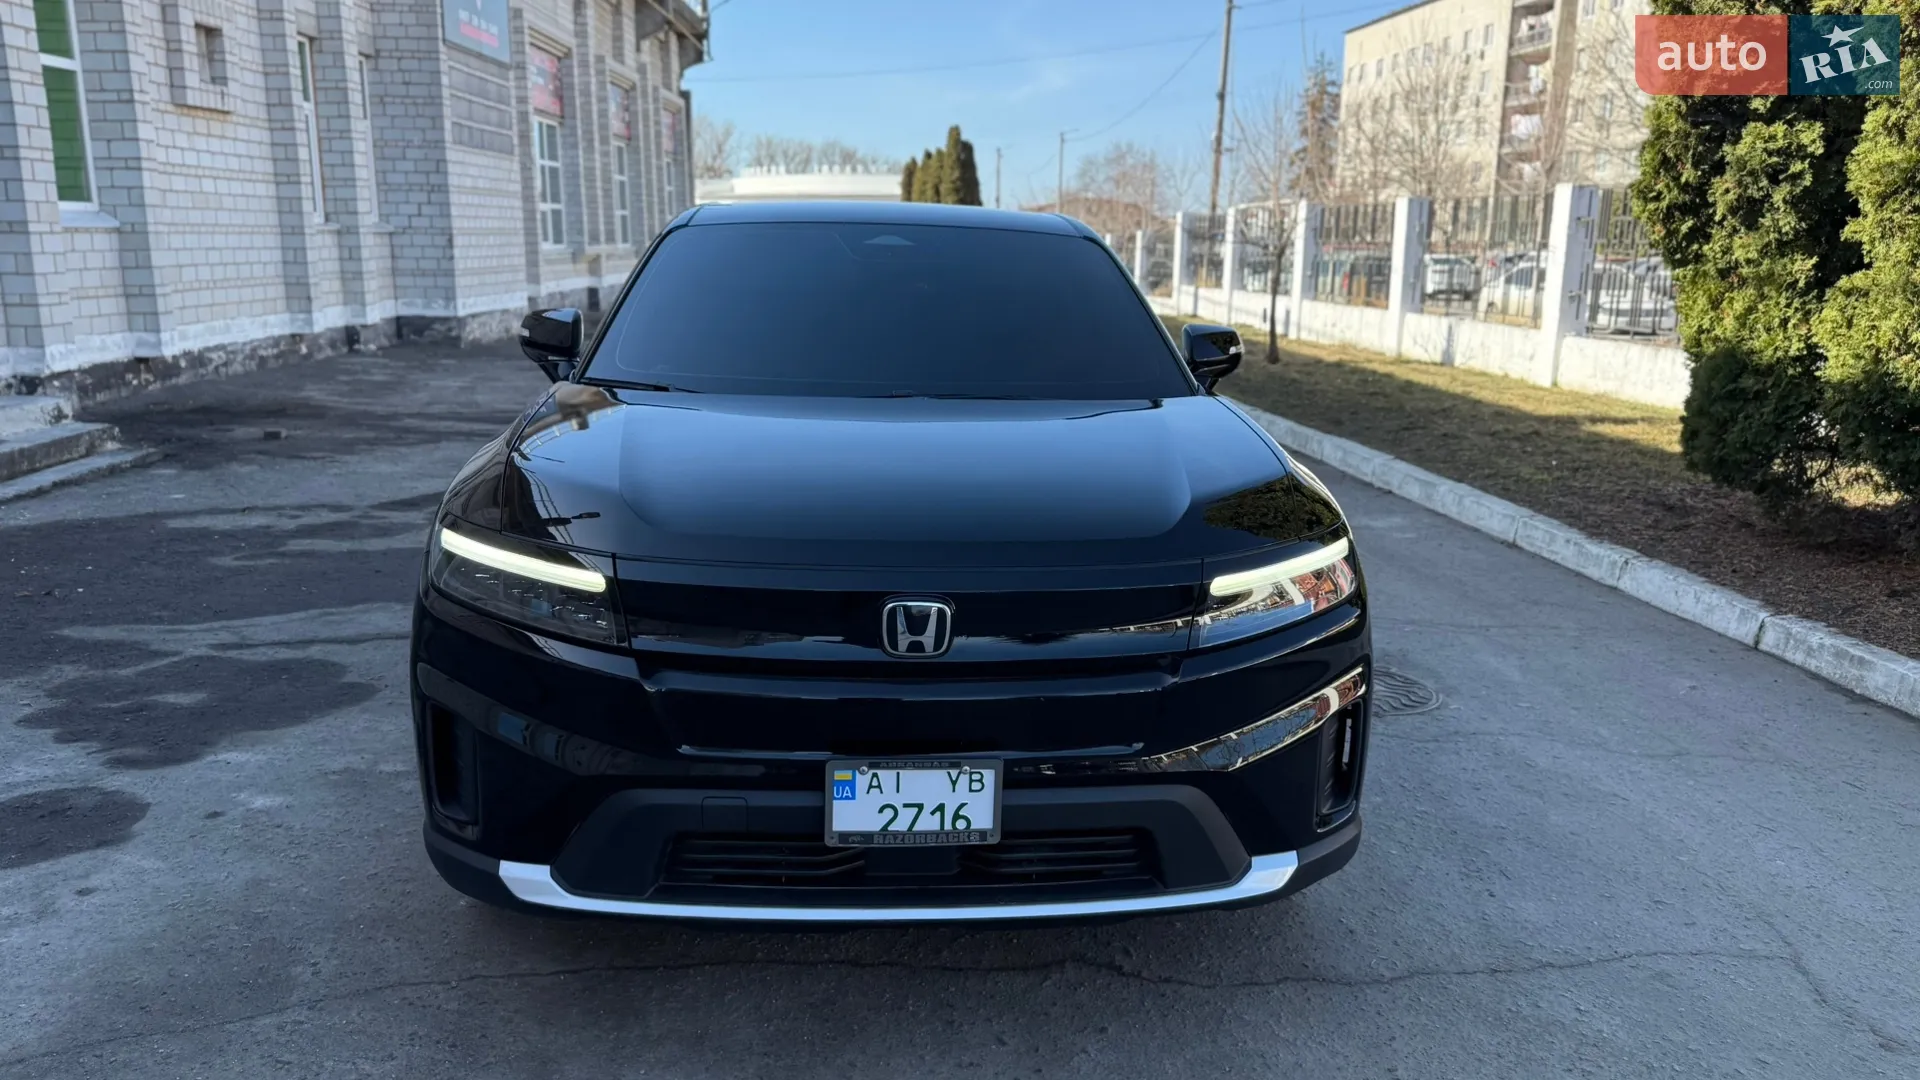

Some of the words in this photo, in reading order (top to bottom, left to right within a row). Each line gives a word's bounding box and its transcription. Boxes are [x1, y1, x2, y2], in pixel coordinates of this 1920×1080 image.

[866, 771, 901, 794] AI
[946, 771, 986, 793] YB
[833, 786, 852, 798] UA
[877, 802, 972, 831] 2716
[873, 832, 980, 844] RAZORBACKS
